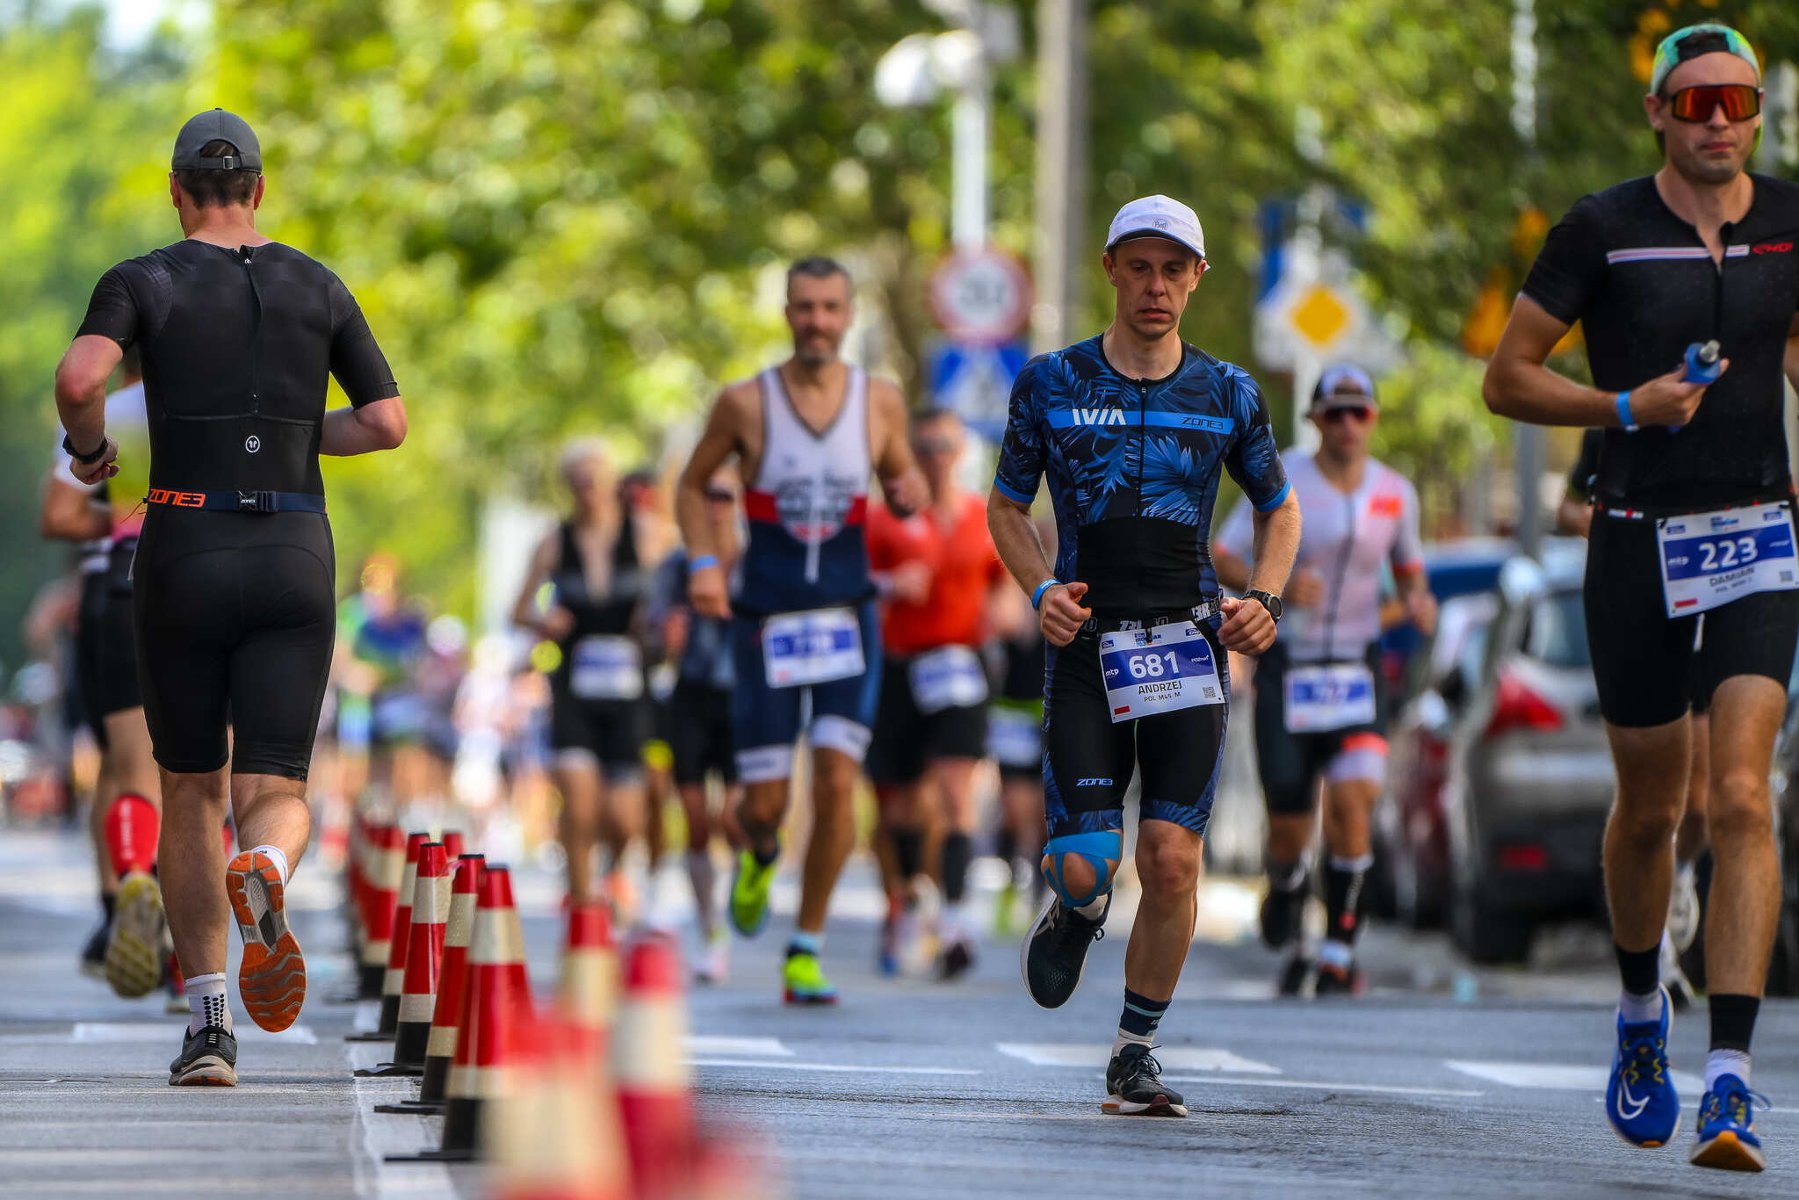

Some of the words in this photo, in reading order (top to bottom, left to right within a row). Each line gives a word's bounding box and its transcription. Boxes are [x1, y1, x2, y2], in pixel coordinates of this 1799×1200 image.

[1698, 536, 1758, 571] 223
[1128, 651, 1180, 679] 681
[1138, 680, 1183, 695] ANDRZEJ
[1076, 777, 1113, 787] ZONE3
